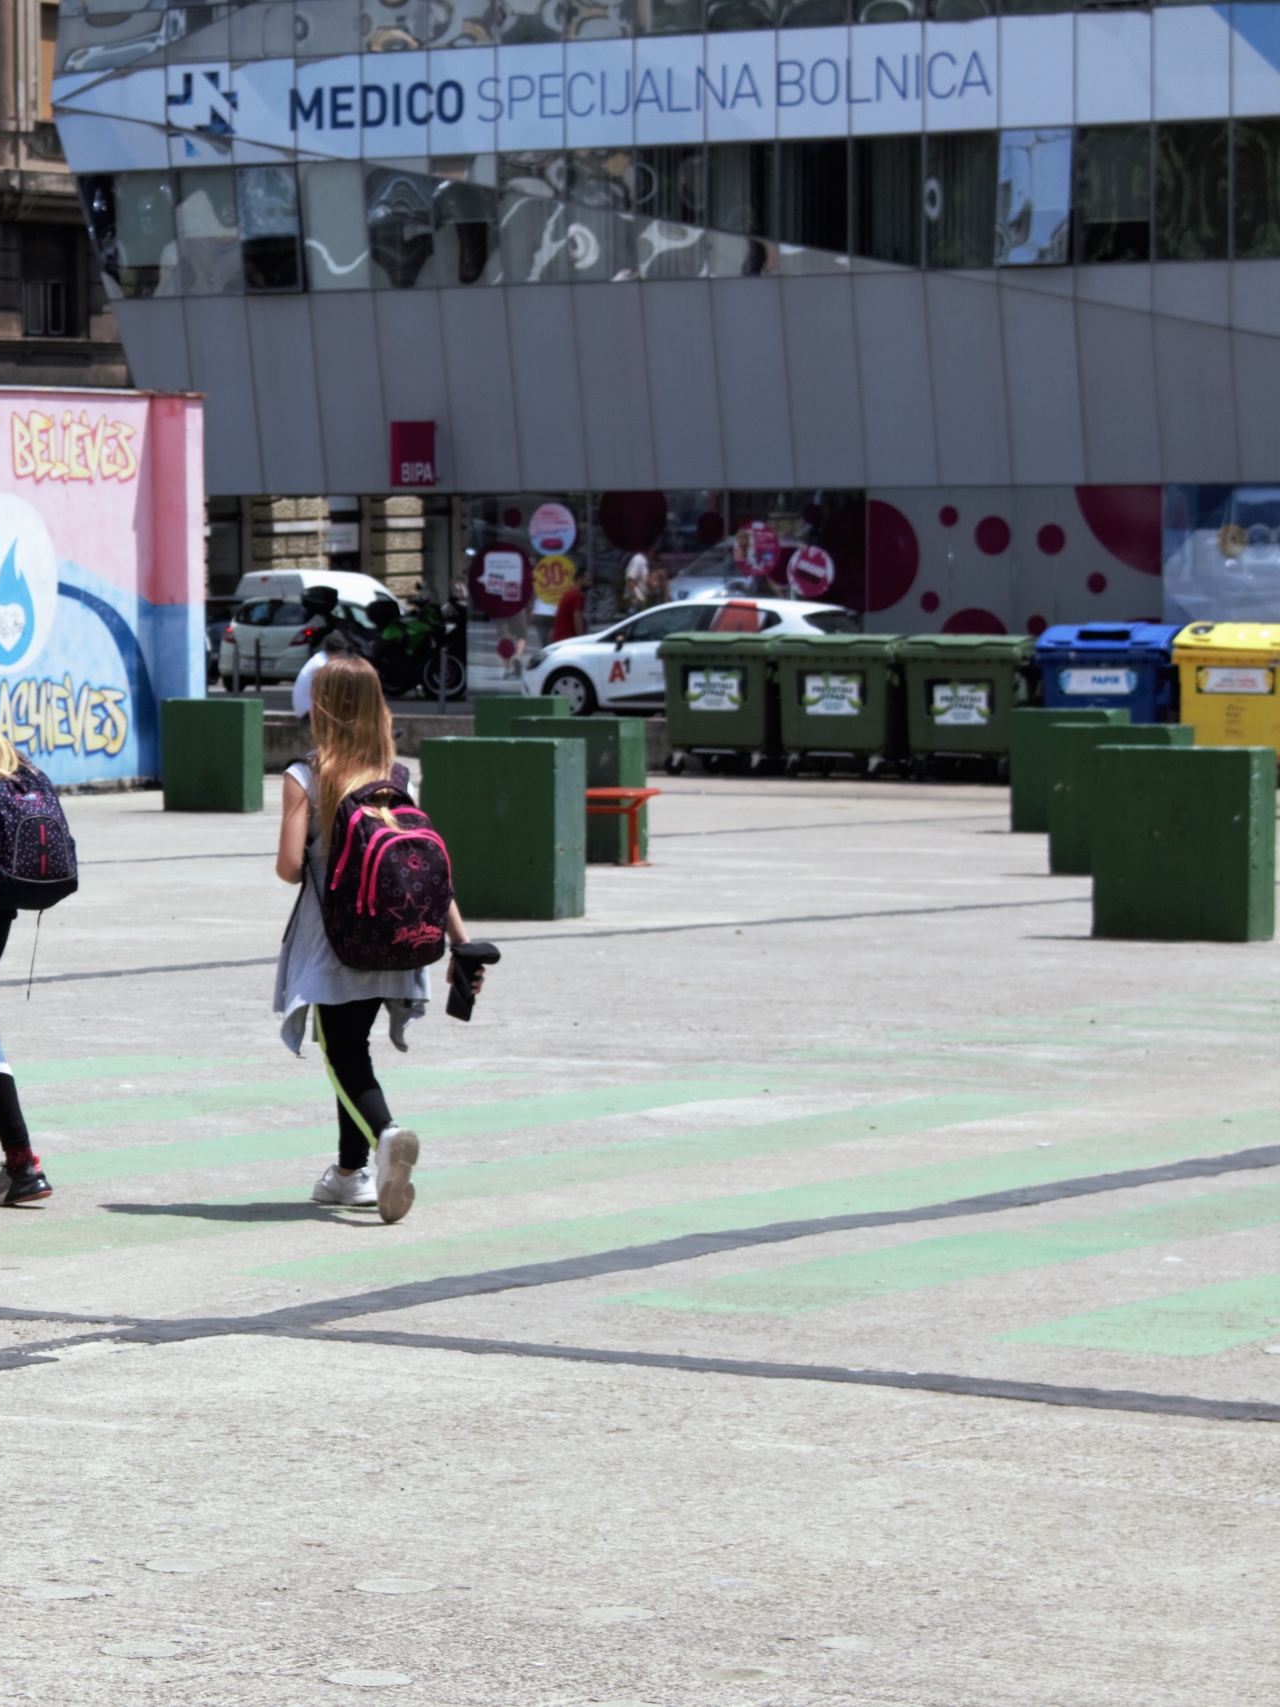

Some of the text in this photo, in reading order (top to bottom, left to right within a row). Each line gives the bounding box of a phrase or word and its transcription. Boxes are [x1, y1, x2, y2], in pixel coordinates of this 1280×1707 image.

[289, 50, 992, 132] MEDICO SPECIJALNA BOLNICA
[401, 461, 433, 483] BIPA
[608, 657, 631, 684] A1
[693, 682, 734, 690] PREOSTALI
[1090, 675, 1120, 686] PAPIR
[701, 689, 726, 697] OTPAD
